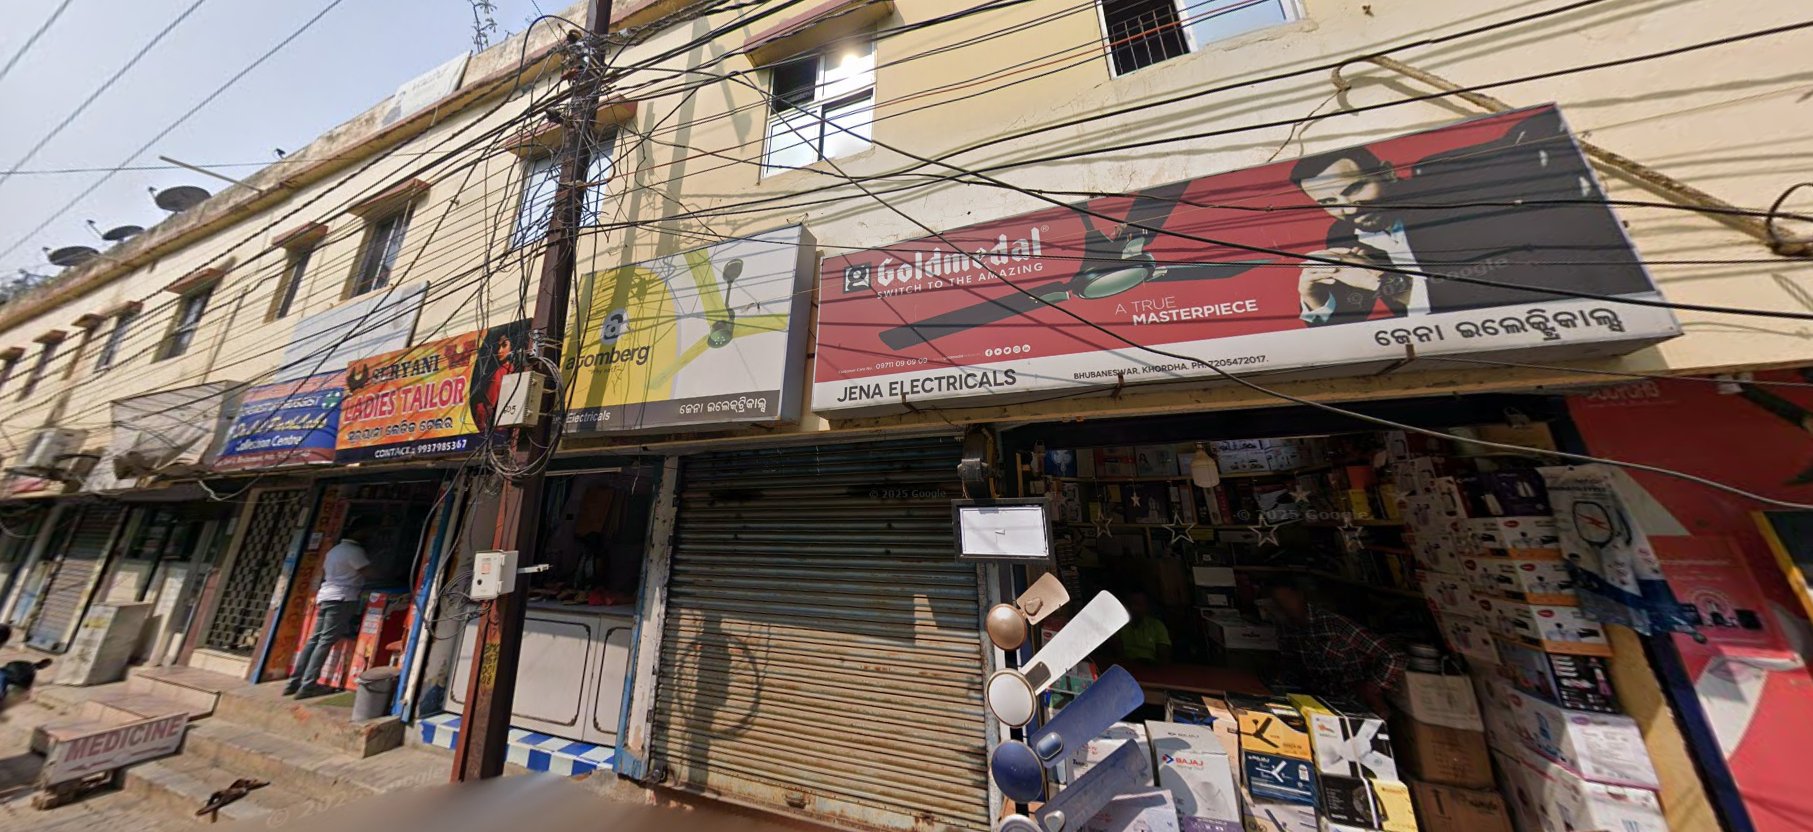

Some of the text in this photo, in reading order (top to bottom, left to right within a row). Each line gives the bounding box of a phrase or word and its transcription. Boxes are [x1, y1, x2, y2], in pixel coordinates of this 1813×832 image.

[877, 226, 1042, 287] Goldmedal
[877, 263, 1043, 299] SWITCH TO THE AMAZING
[1115, 296, 1177, 316] A TRUE
[1133, 299, 1258, 326] MASTERPIECE
[1374, 324, 1444, 346] ଜେନା
[565, 345, 650, 370] atomberg
[837, 368, 1017, 402] JENA ELECTRICALS
[343, 390, 396, 423] LADIES
[401, 376, 466, 413] TAILOR
[566, 410, 611, 424] Electricals
[64, 715, 182, 762] MEDICINE
[1176, 757, 1204, 767] BAJAJ
